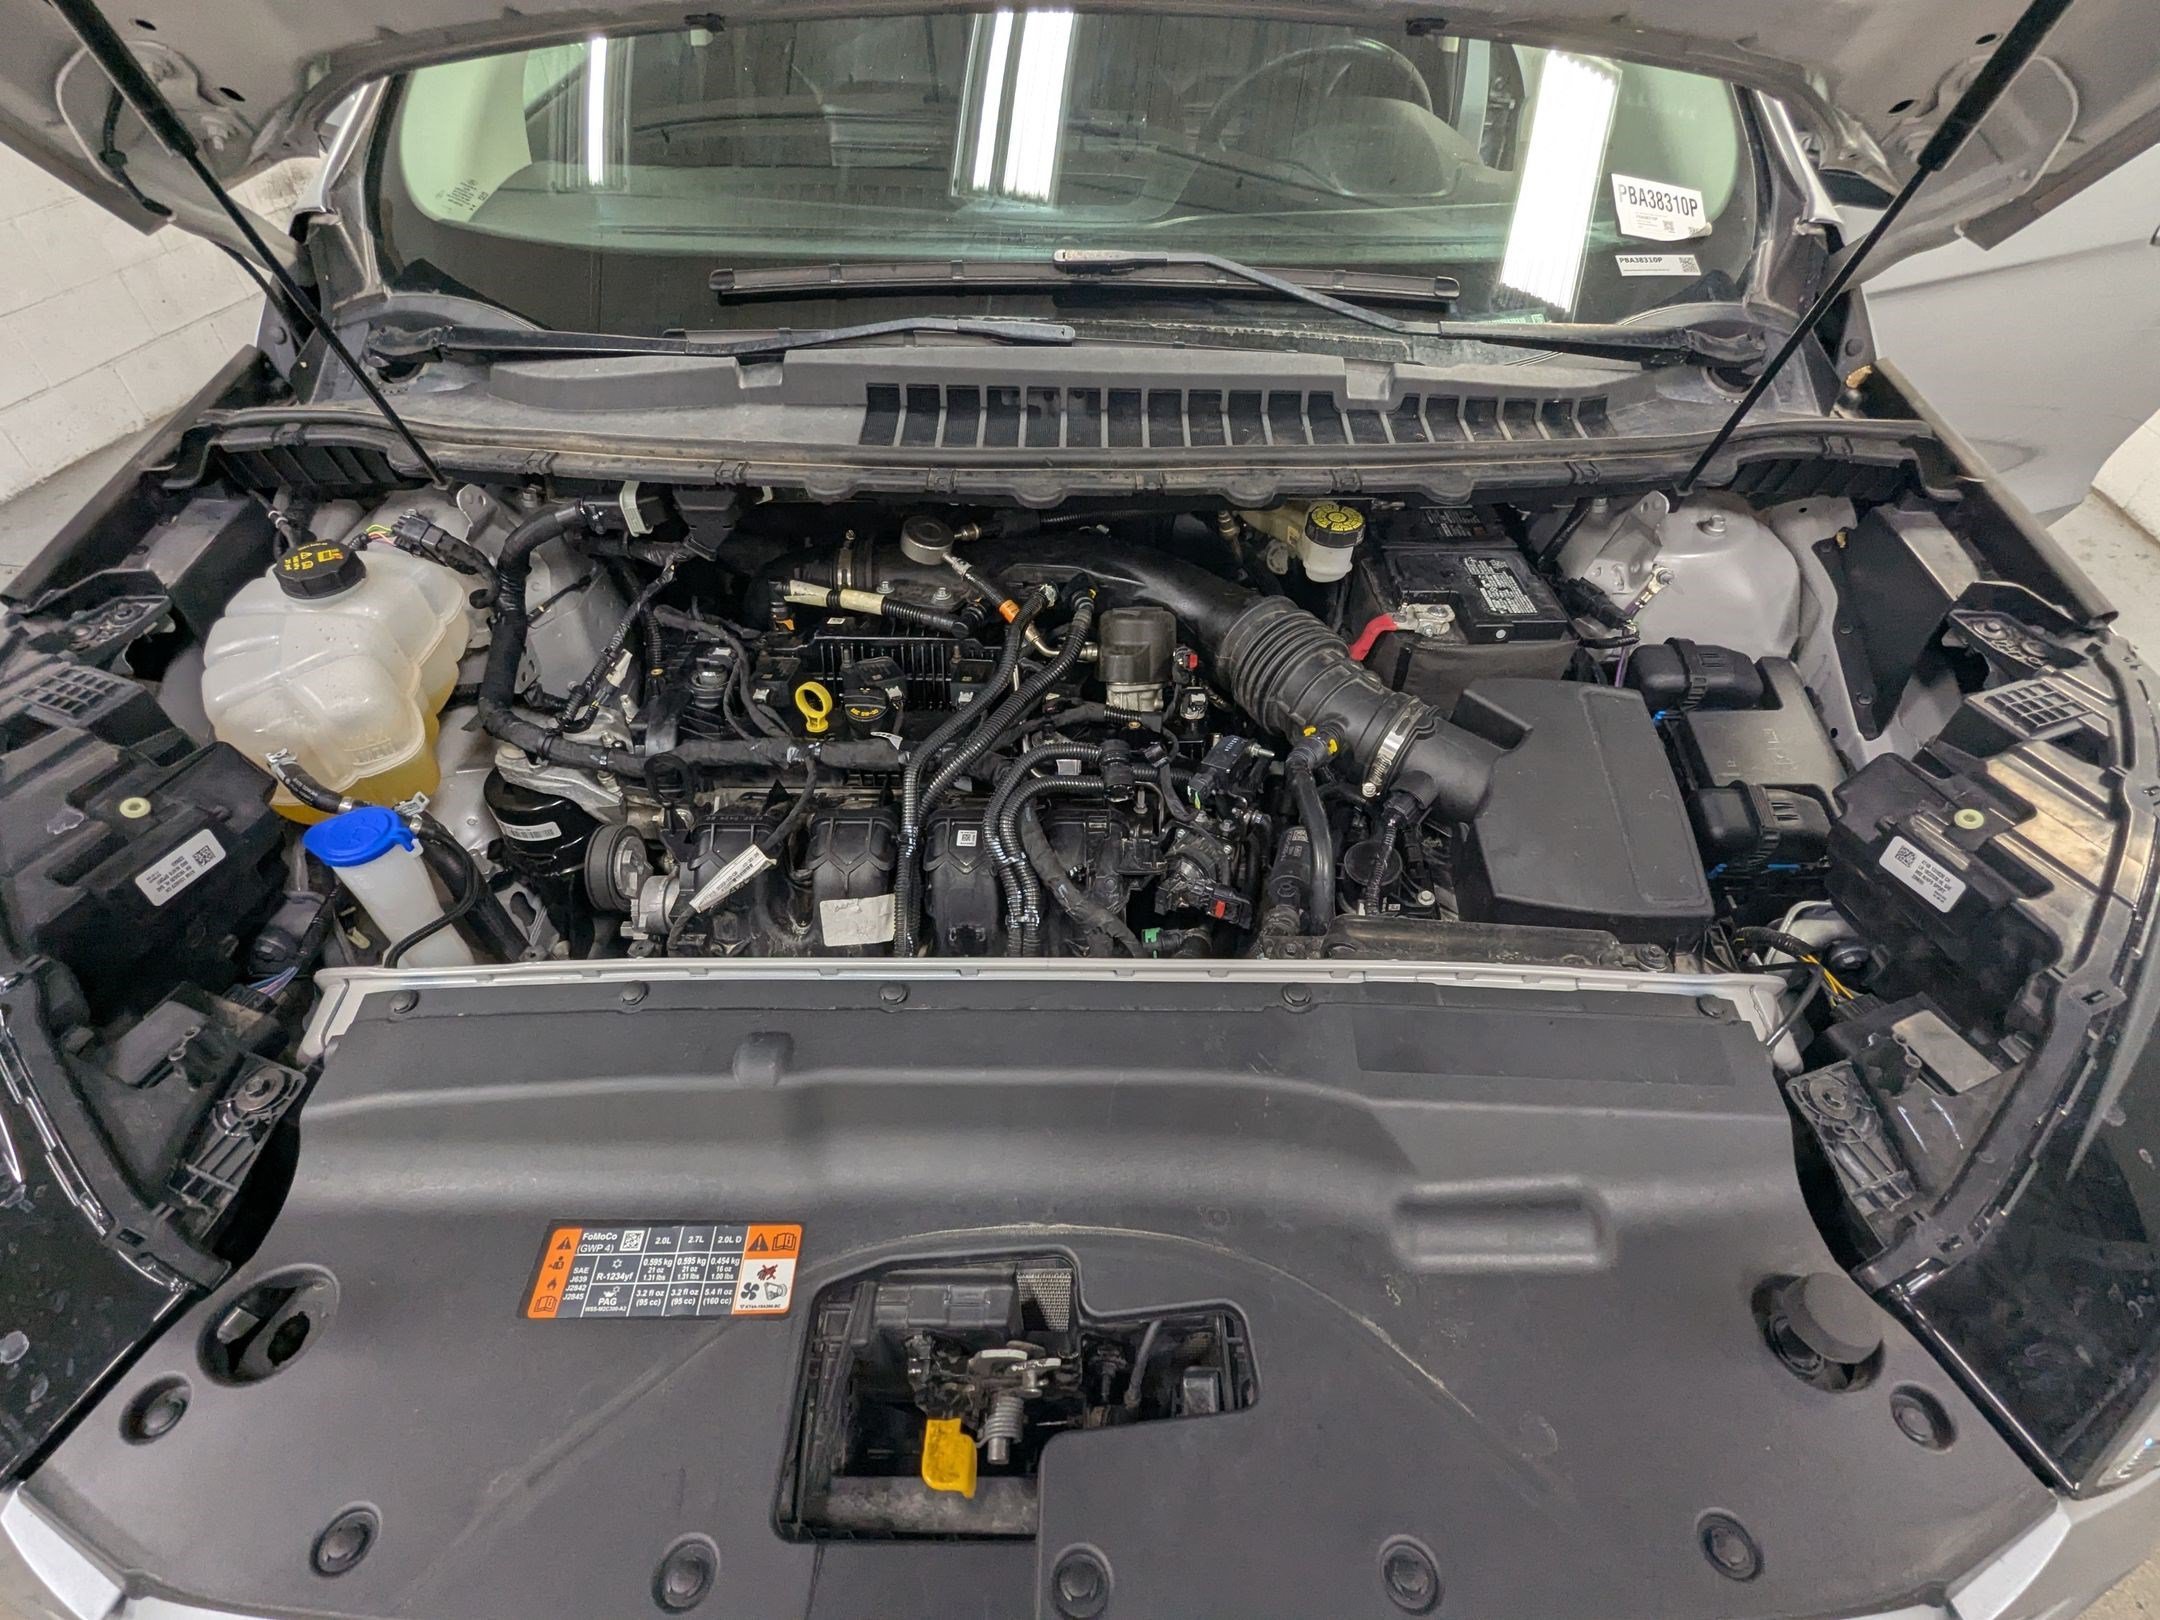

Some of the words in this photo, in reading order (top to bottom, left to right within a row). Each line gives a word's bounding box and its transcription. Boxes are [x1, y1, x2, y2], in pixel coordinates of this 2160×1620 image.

[1618, 183, 1698, 217] PBA38310P
[582, 1232, 618, 1240] FoMoCo
[577, 1244, 603, 1254] (GWP
[604, 1244, 614, 1253] 4)
[643, 1258, 663, 1266] 0.595
[663, 1258, 673, 1268] kg
[677, 1257, 696, 1265] 0.595
[697, 1257, 707, 1267] kg
[731, 1257, 740, 1266] kg
[596, 1272, 634, 1282] R-1234yf
[598, 1298, 617, 1306] PAG
[636, 1298, 648, 1307] (95
[649, 1298, 661, 1307] cc)
[671, 1298, 683, 1307] (95
[684, 1298, 696, 1306] cc)
[703, 1298, 719, 1306] (160
[720, 1298, 732, 1306] cc)
